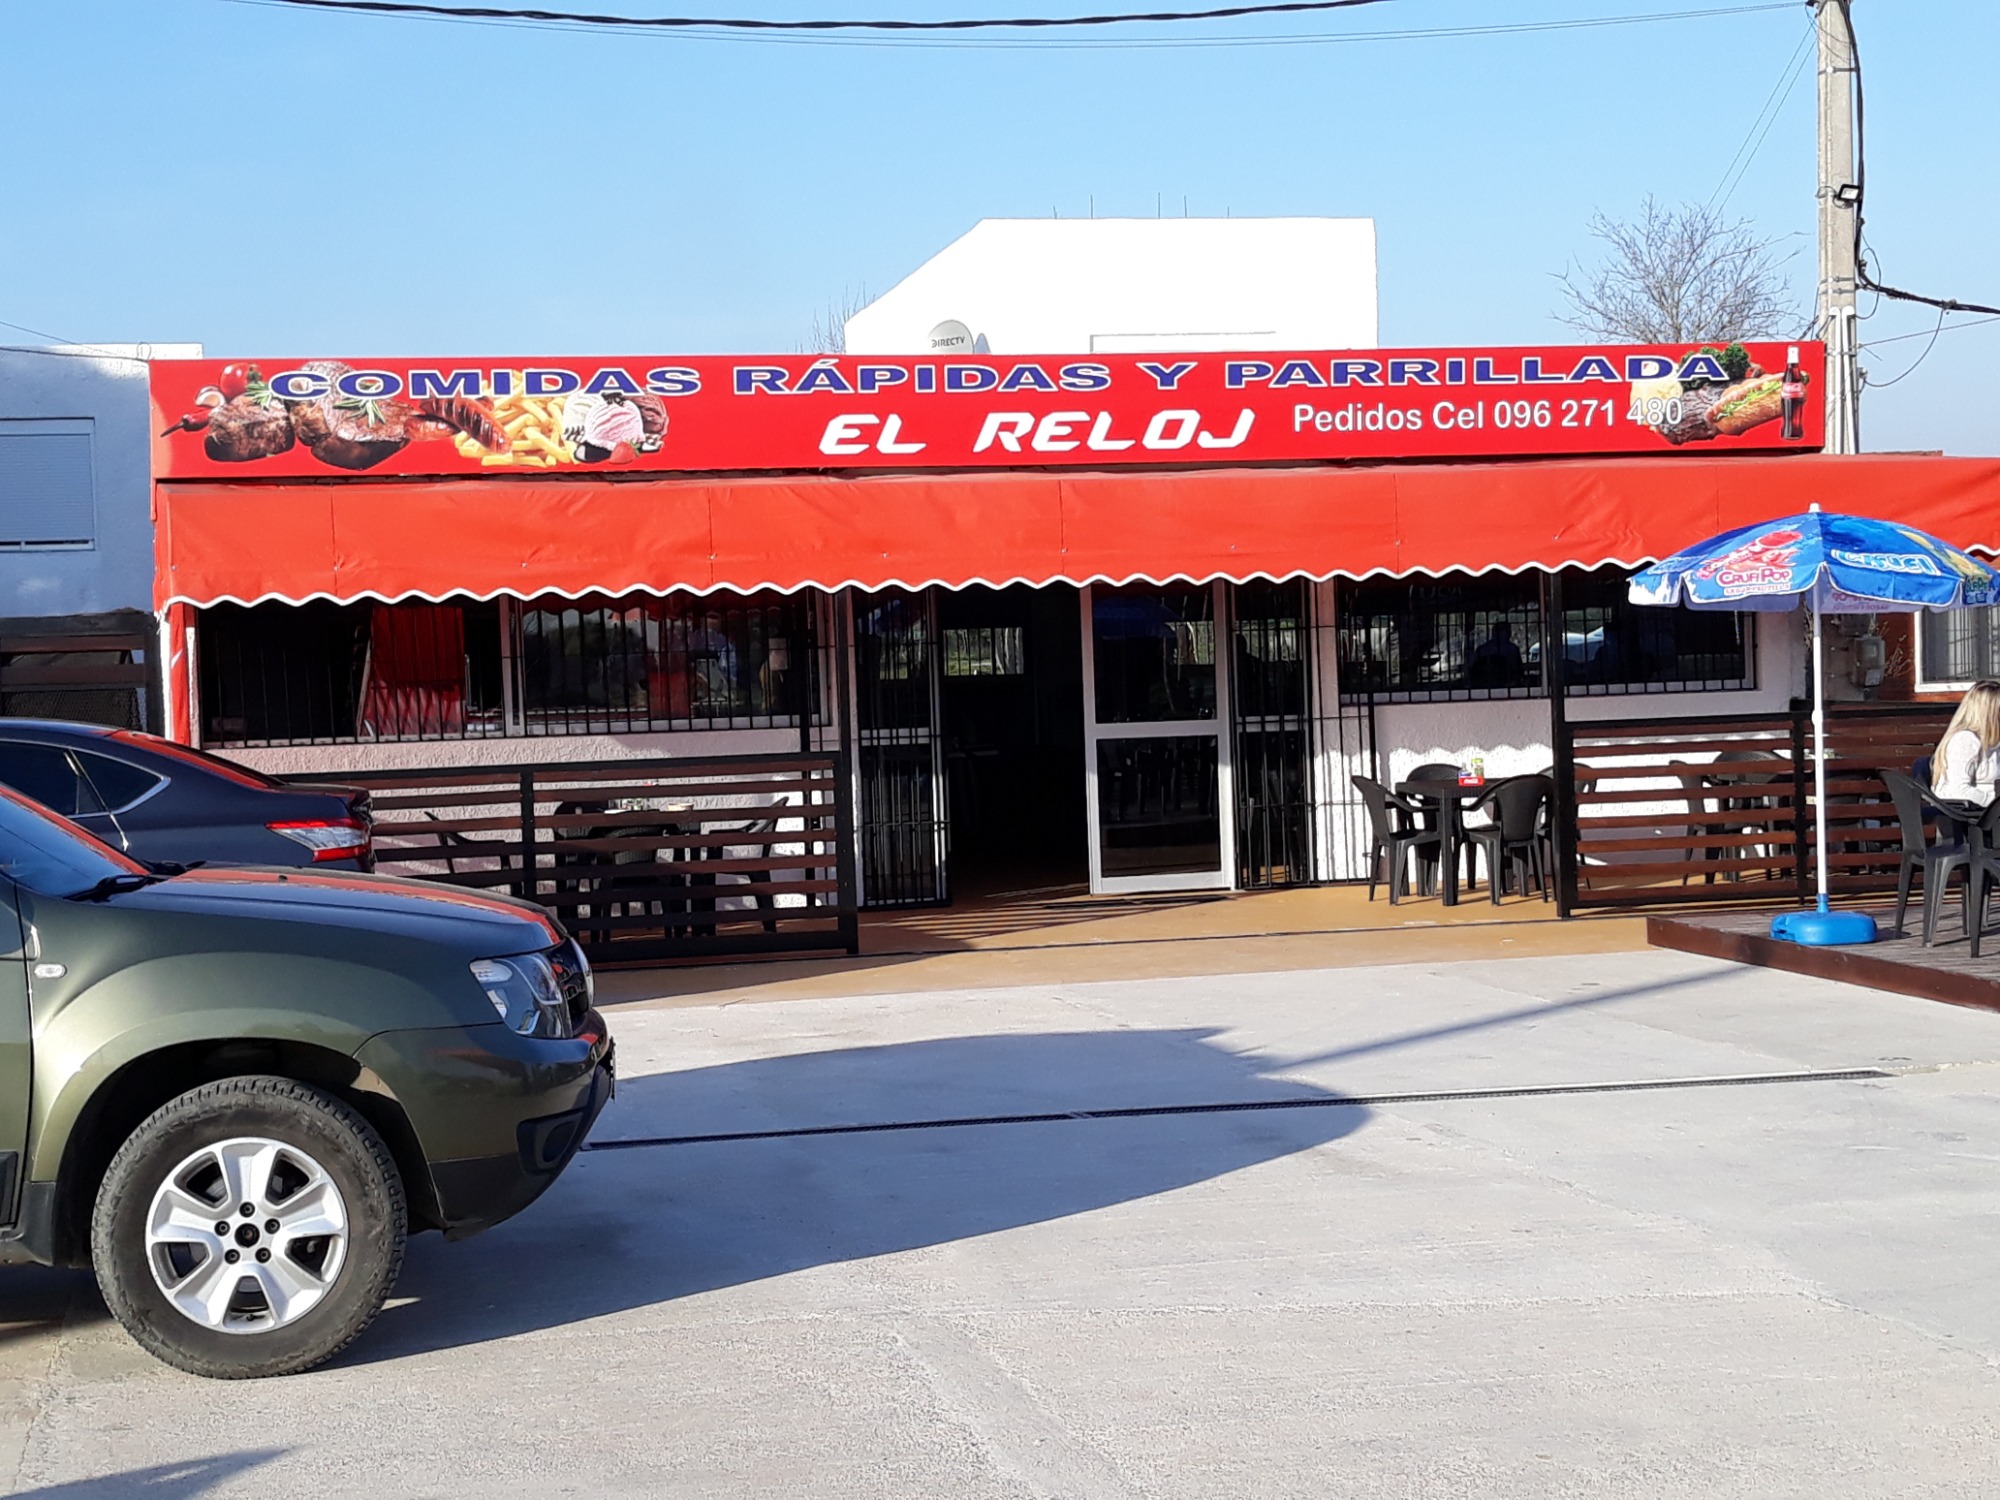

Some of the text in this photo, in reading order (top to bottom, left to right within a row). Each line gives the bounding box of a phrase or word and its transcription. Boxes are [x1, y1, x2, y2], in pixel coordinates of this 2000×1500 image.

[931, 336, 965, 348] DIRECTV
[268, 355, 1730, 400] COMIDAS RÁPIDAS Y PARRILLADA
[819, 408, 1256, 455] EL RELOJ
[1294, 396, 1683, 433] Pedidos Cel 096 271 480
